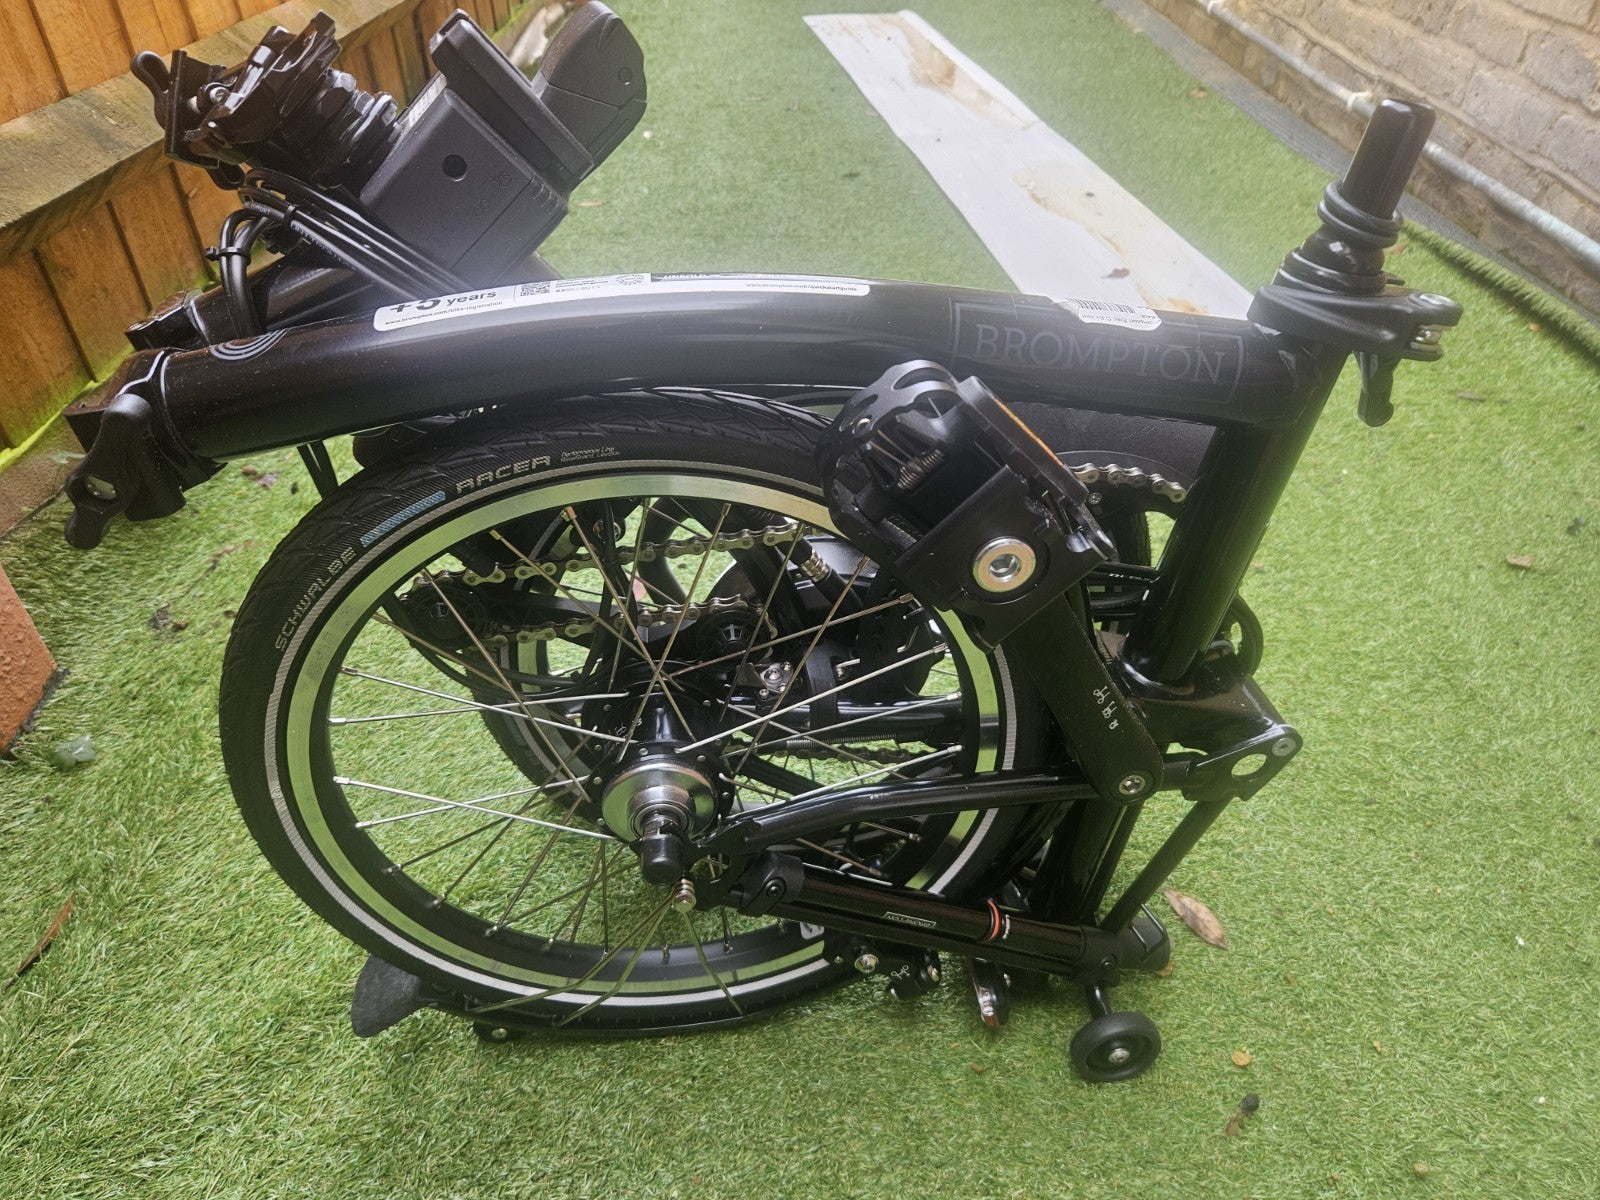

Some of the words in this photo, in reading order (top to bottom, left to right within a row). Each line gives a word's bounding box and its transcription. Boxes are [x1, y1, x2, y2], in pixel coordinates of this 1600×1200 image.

[446, 290, 497, 307] years
[976, 323, 1225, 385] BROMPTON
[456, 454, 551, 494] RACER
[274, 546, 357, 652] SCHWALBE
